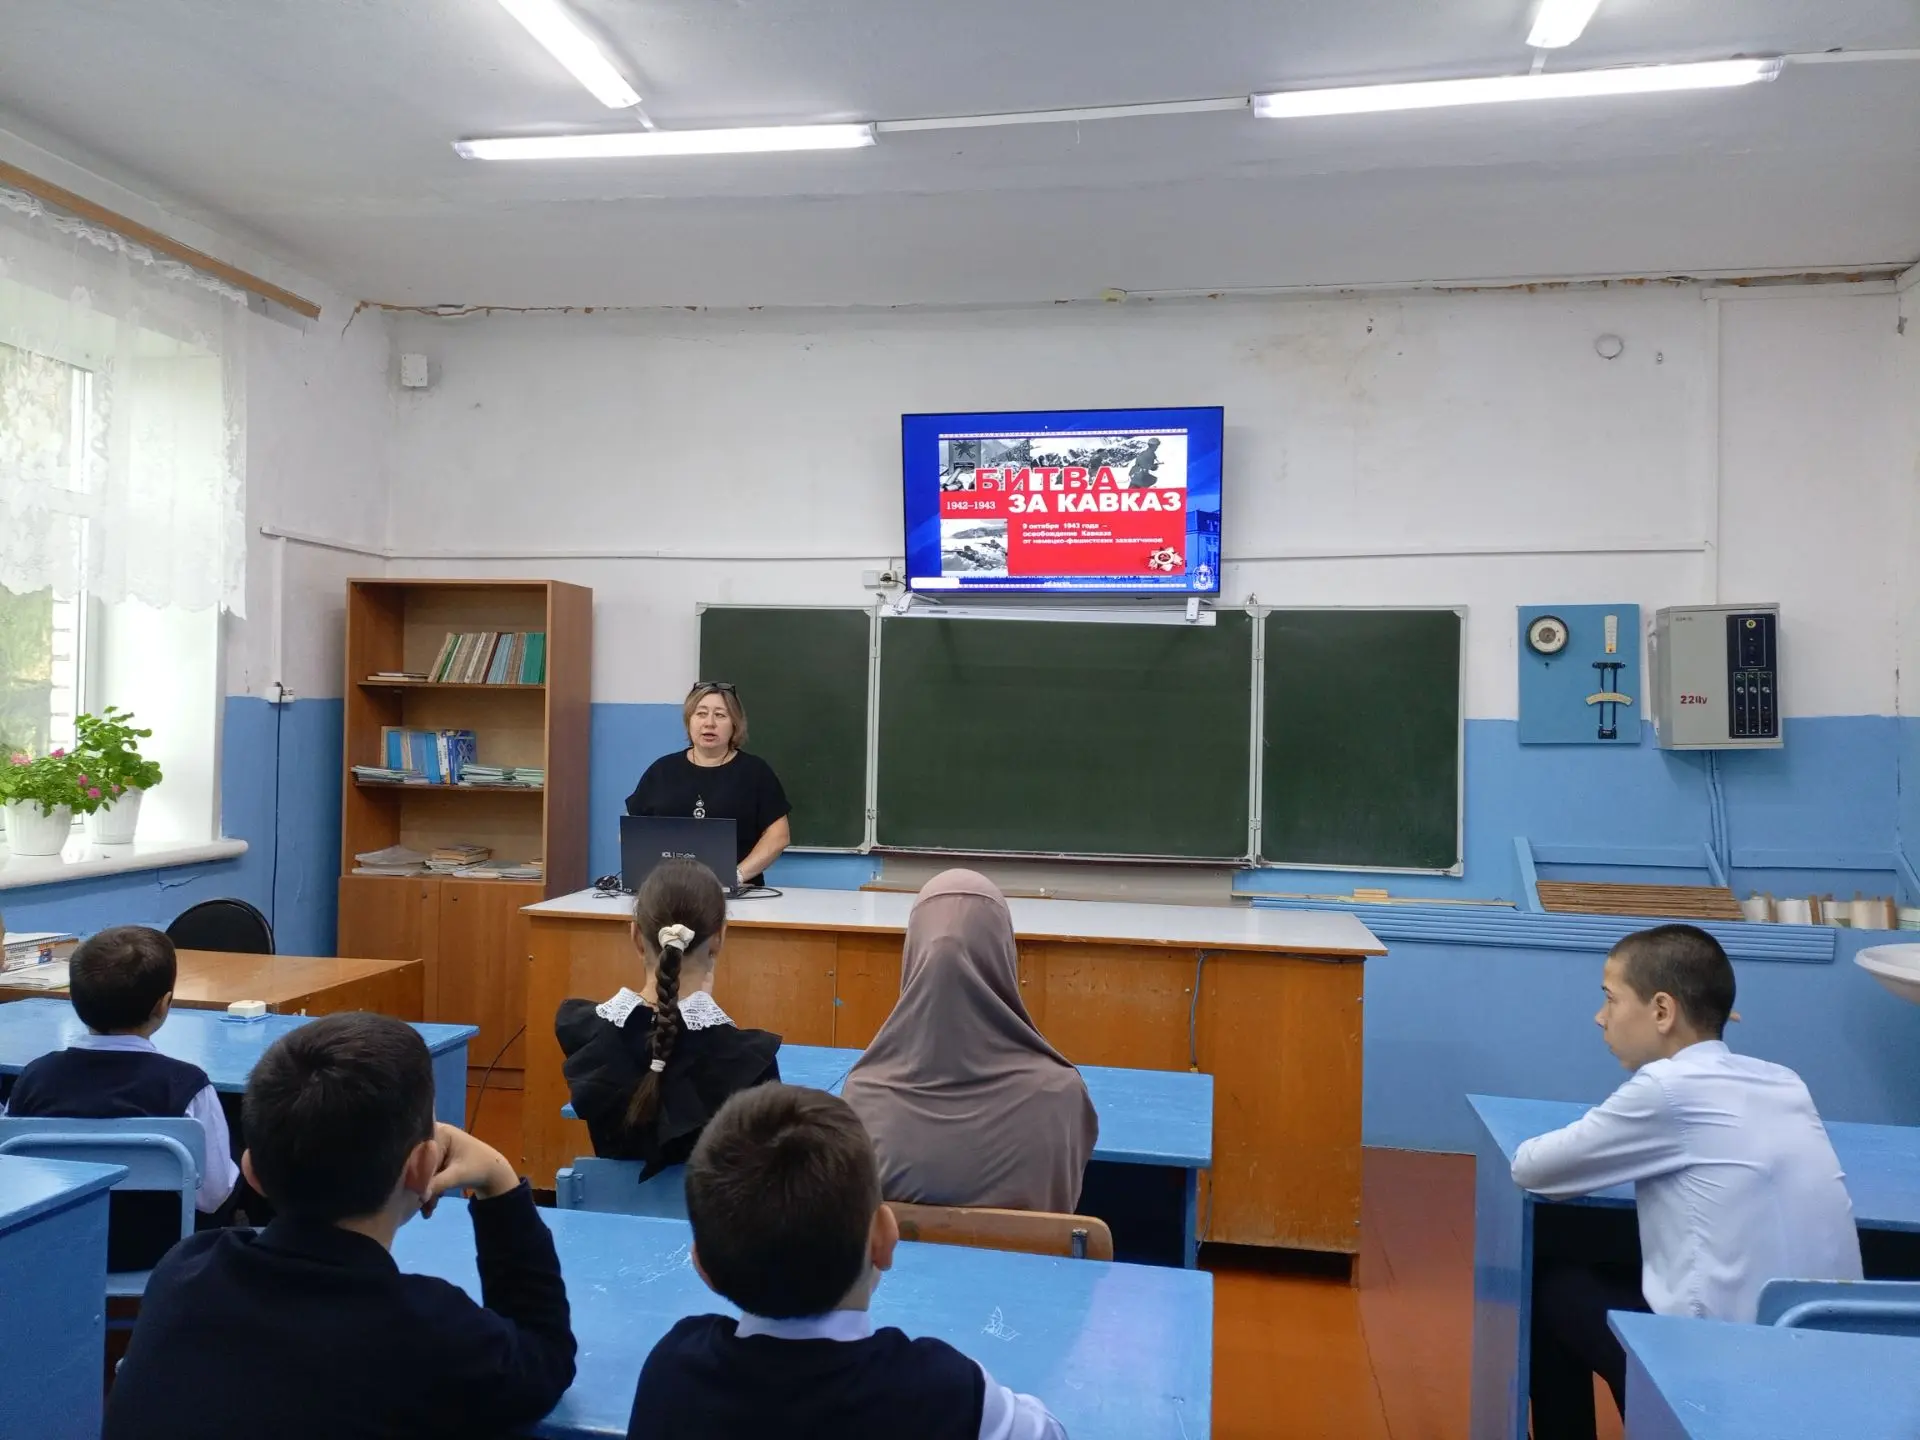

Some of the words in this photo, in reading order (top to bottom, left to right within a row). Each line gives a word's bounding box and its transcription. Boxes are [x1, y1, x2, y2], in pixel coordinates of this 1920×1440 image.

[974, 466, 1119, 492] БИТВА
[1008, 493, 1048, 514] ЗА
[1057, 491, 1182, 513] КАВКАЗ
